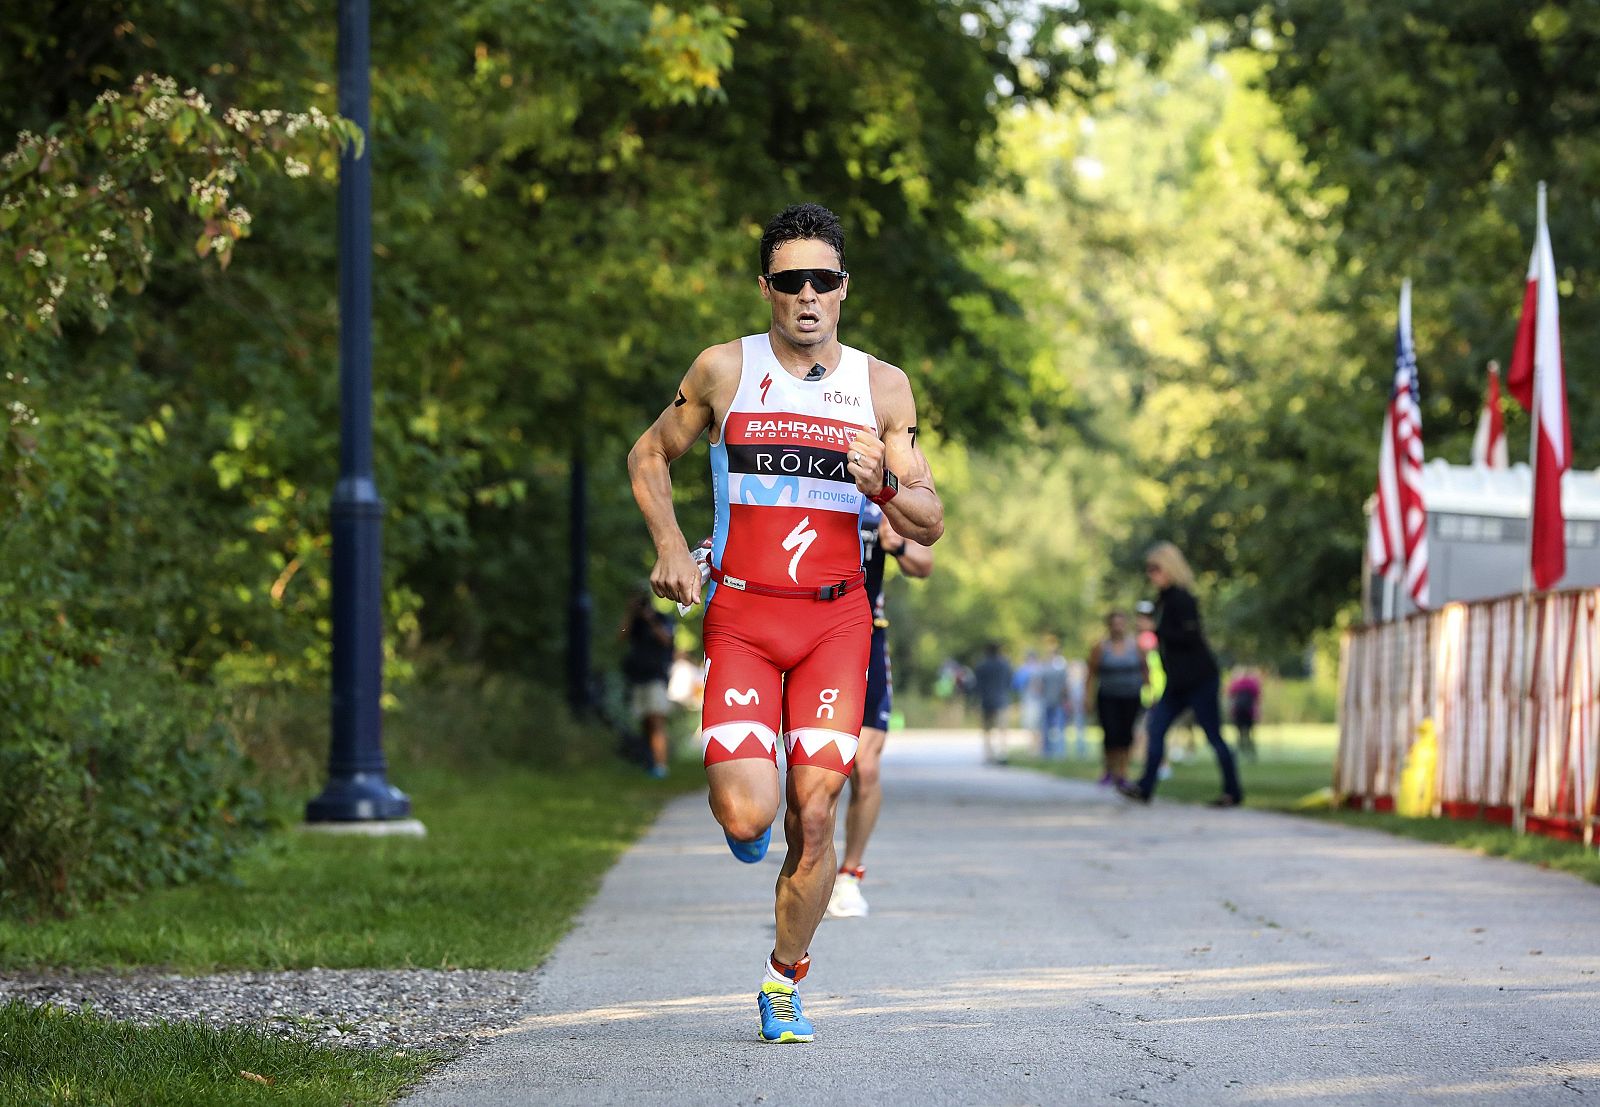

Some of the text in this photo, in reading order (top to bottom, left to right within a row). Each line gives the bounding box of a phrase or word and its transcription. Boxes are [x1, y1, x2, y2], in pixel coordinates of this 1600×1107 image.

[746, 420, 844, 439] BAHRAIN
[744, 431, 845, 446] ENDURANCE
[807, 488, 858, 505] movistar
